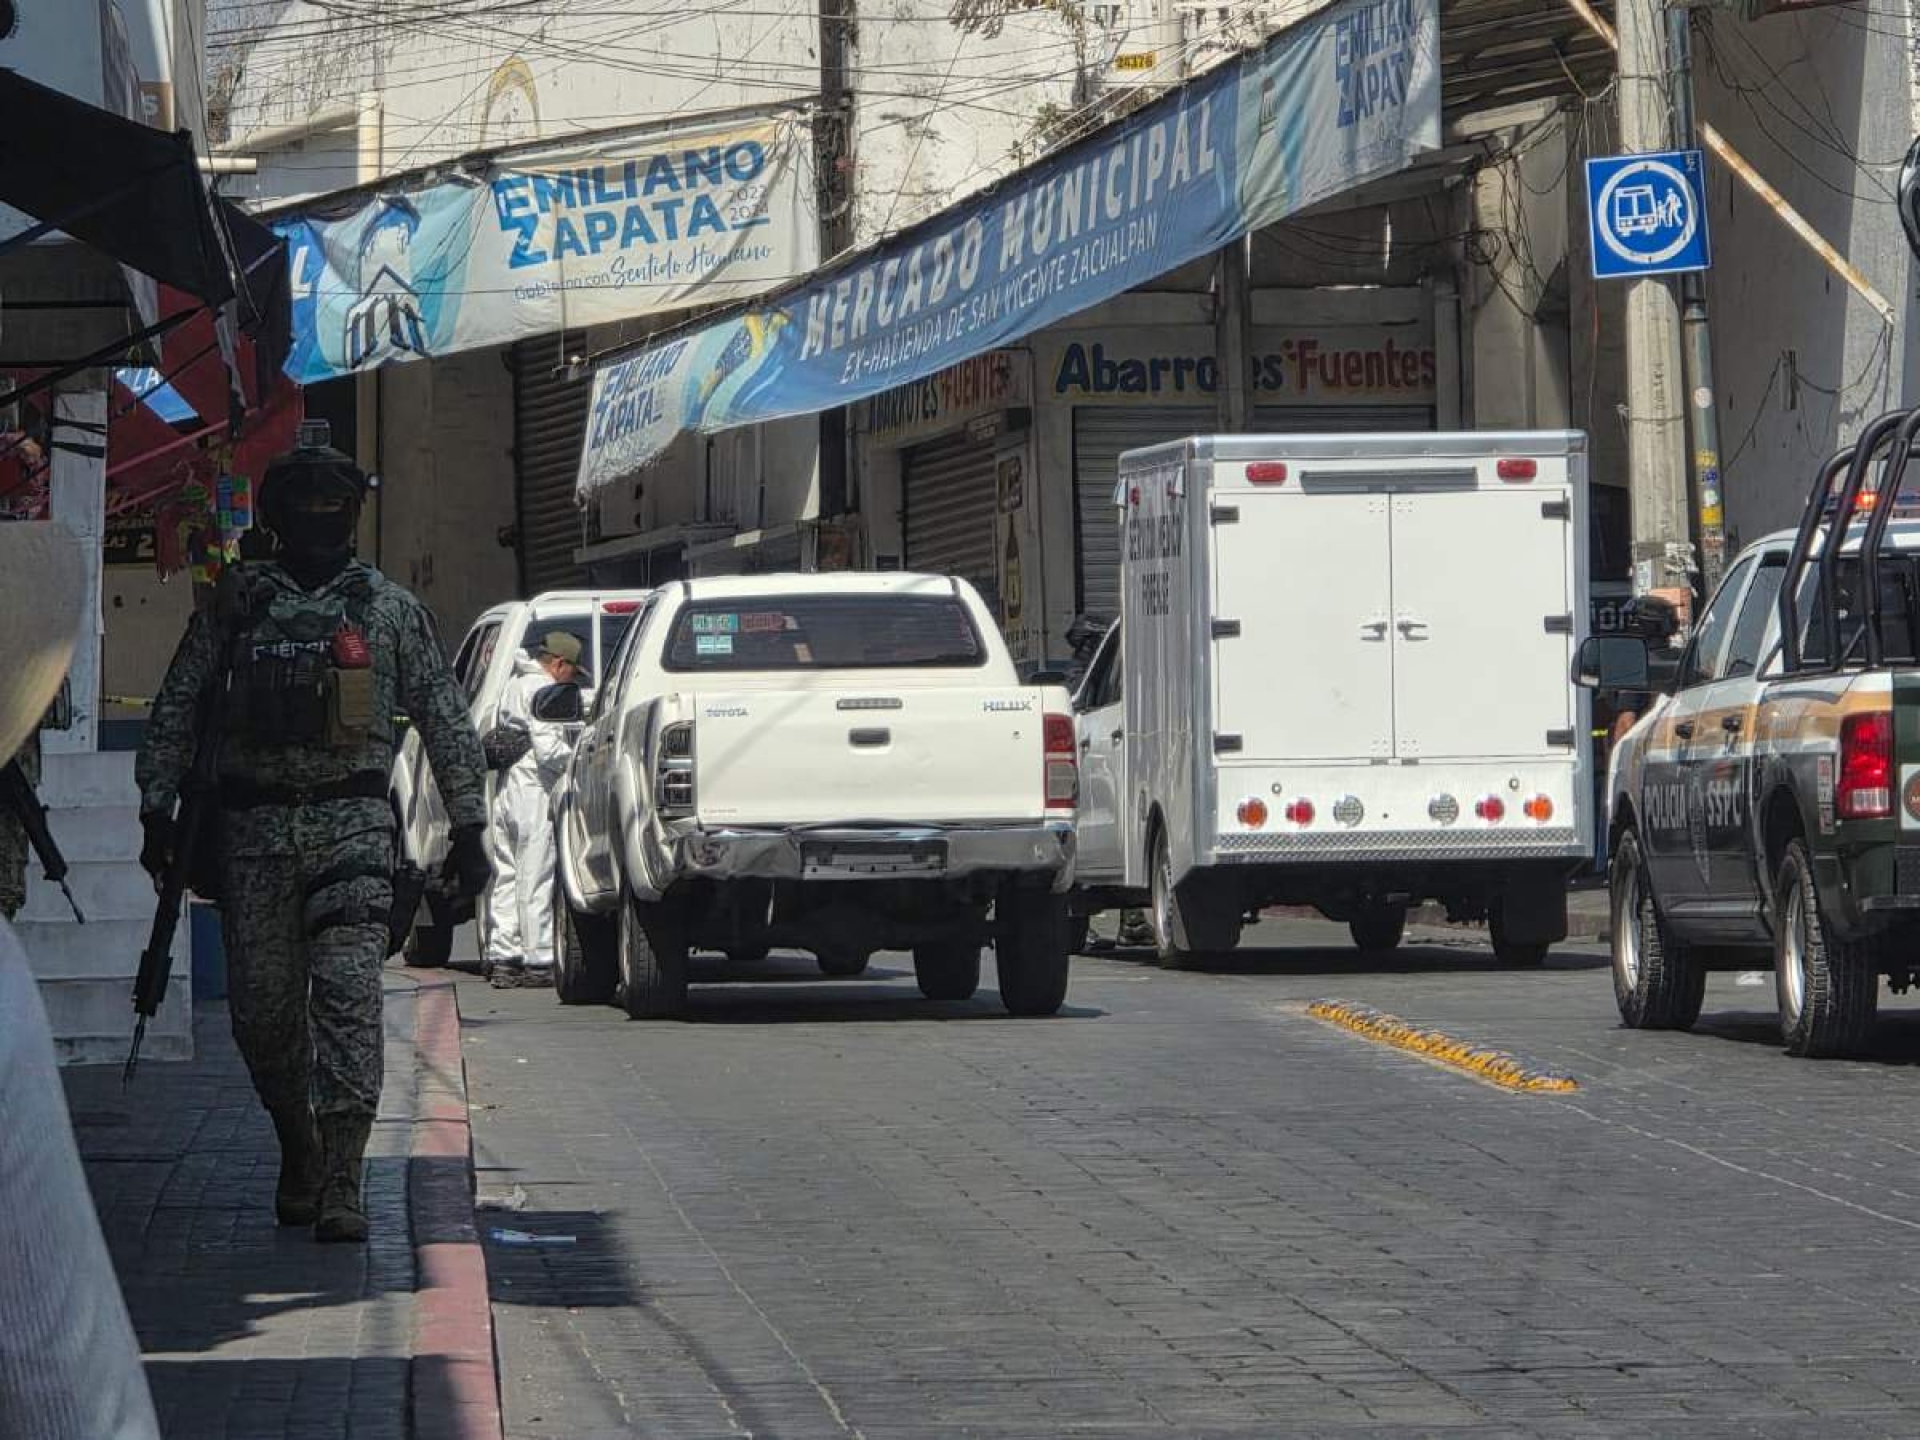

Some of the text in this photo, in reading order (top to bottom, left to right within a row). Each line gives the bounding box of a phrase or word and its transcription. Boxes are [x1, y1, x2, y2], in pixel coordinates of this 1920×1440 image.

[492, 140, 765, 217] EMILIANO
[500, 194, 727, 269] ZAPATA
[799, 97, 1215, 361] MERCADO MUNICIPAL
[610, 250, 681, 290] Sentido
[840, 313, 943, 385] EX-HACIENDA
[946, 302, 967, 342] DE
[968, 285, 1000, 331] SAN
[1070, 209, 1159, 286] ZACUALPAN
[1056, 342, 1282, 394] Abarroes
[983, 699, 1033, 712] HILUX
